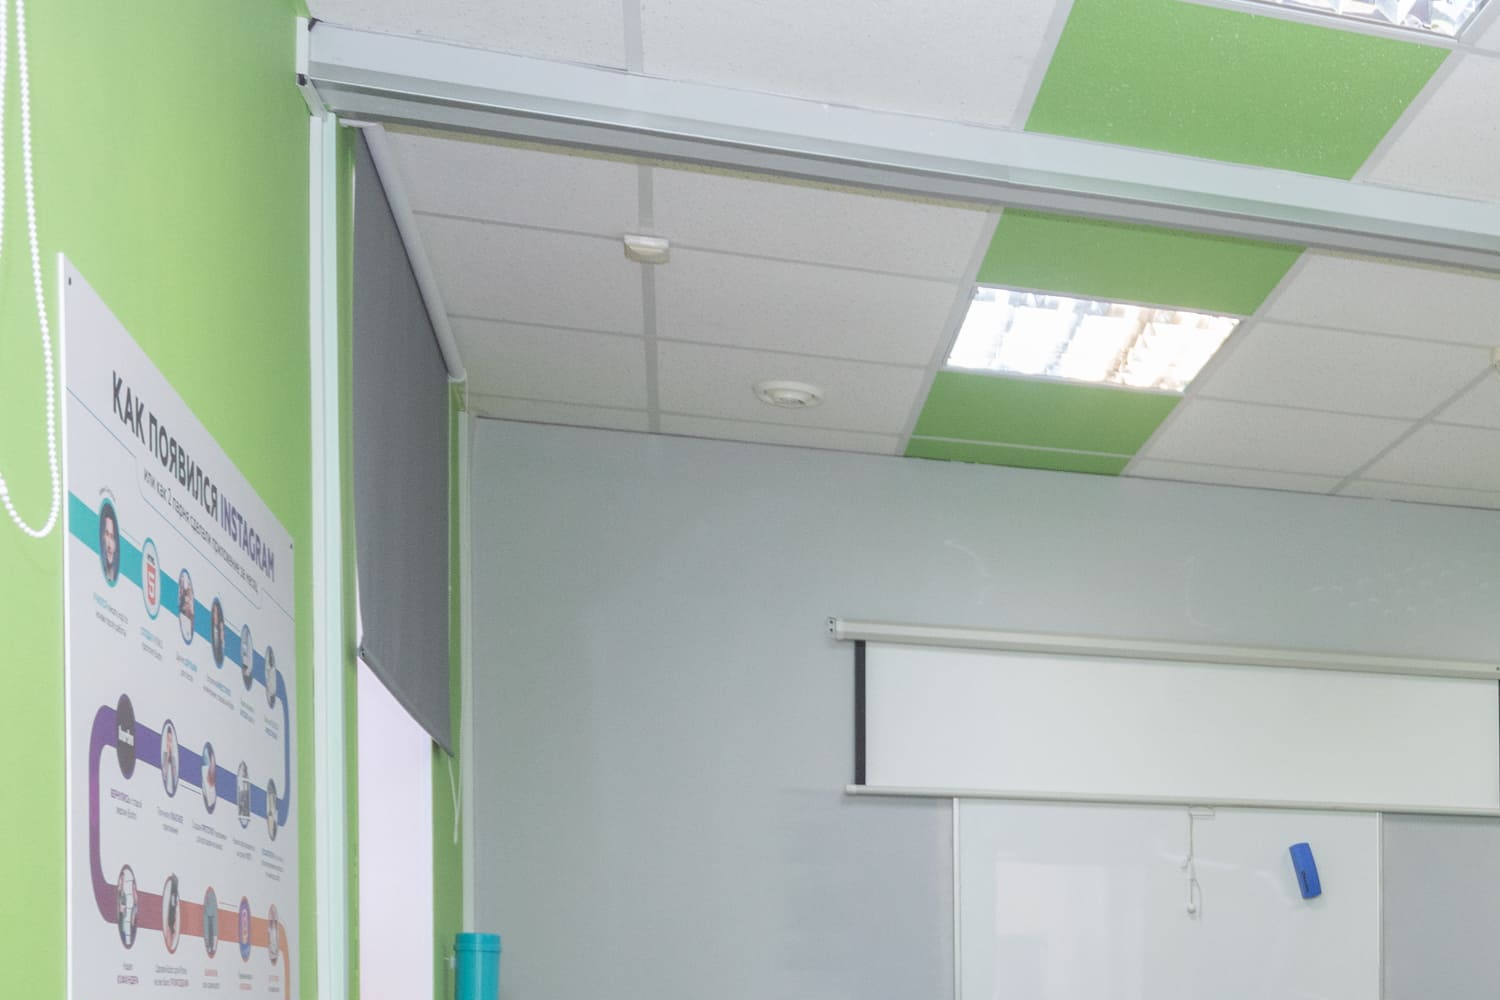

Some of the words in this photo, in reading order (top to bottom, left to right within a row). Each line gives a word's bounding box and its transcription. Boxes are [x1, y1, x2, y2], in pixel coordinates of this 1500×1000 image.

[112, 369, 146, 445] КАК
[148, 411, 218, 522] ПОЯВИЛСЯ
[220, 493, 275, 583] INSTAGRAM
